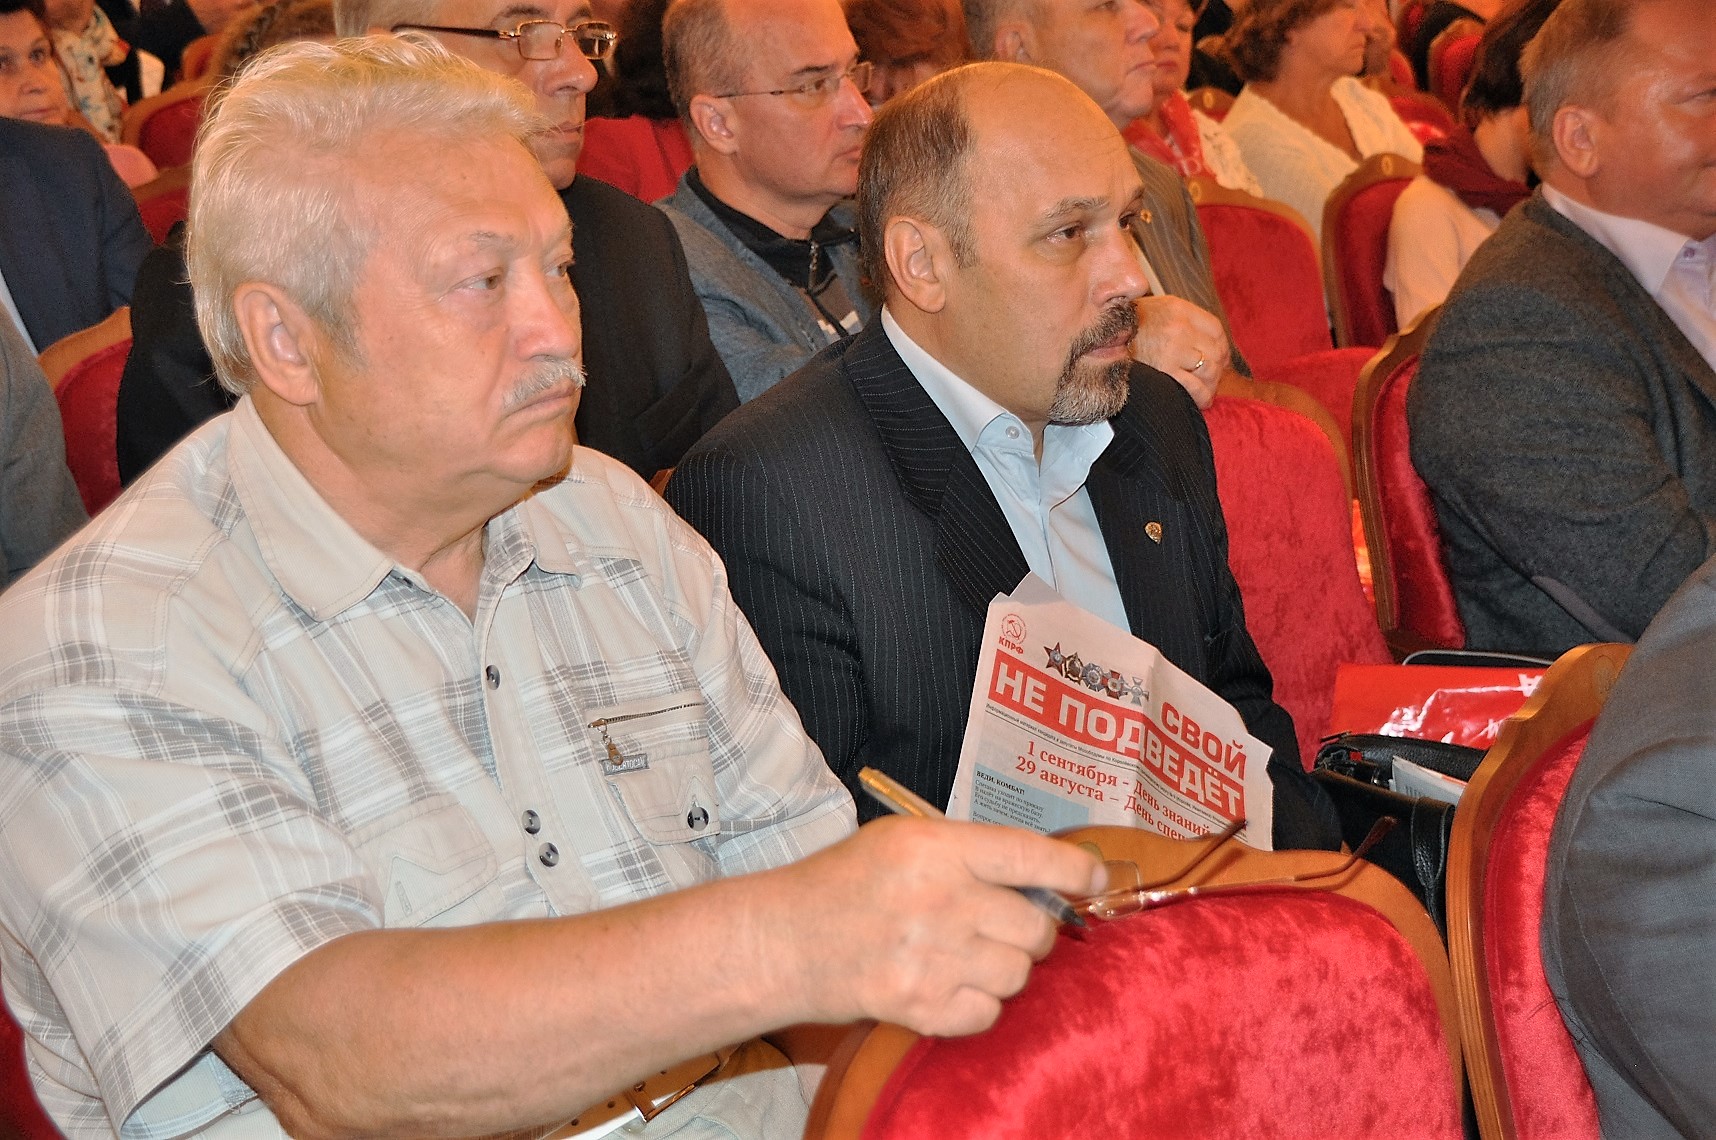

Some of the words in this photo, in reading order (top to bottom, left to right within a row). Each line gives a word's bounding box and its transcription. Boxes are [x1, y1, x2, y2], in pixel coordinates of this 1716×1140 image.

[998, 636, 1024, 654] КПРФ
[996, 662, 1047, 714] НЕ
[1059, 696, 1241, 817] ПОДВЕДЁТ
[1161, 702, 1247, 780] СВОЙ
[1015, 755, 1036, 775] 29
[1039, 769, 1104, 802] августа
[1123, 796, 1154, 826] День
[1027, 741, 1035, 756] 1
[1040, 750, 1118, 786] сентября
[1133, 779, 1160, 811] День
